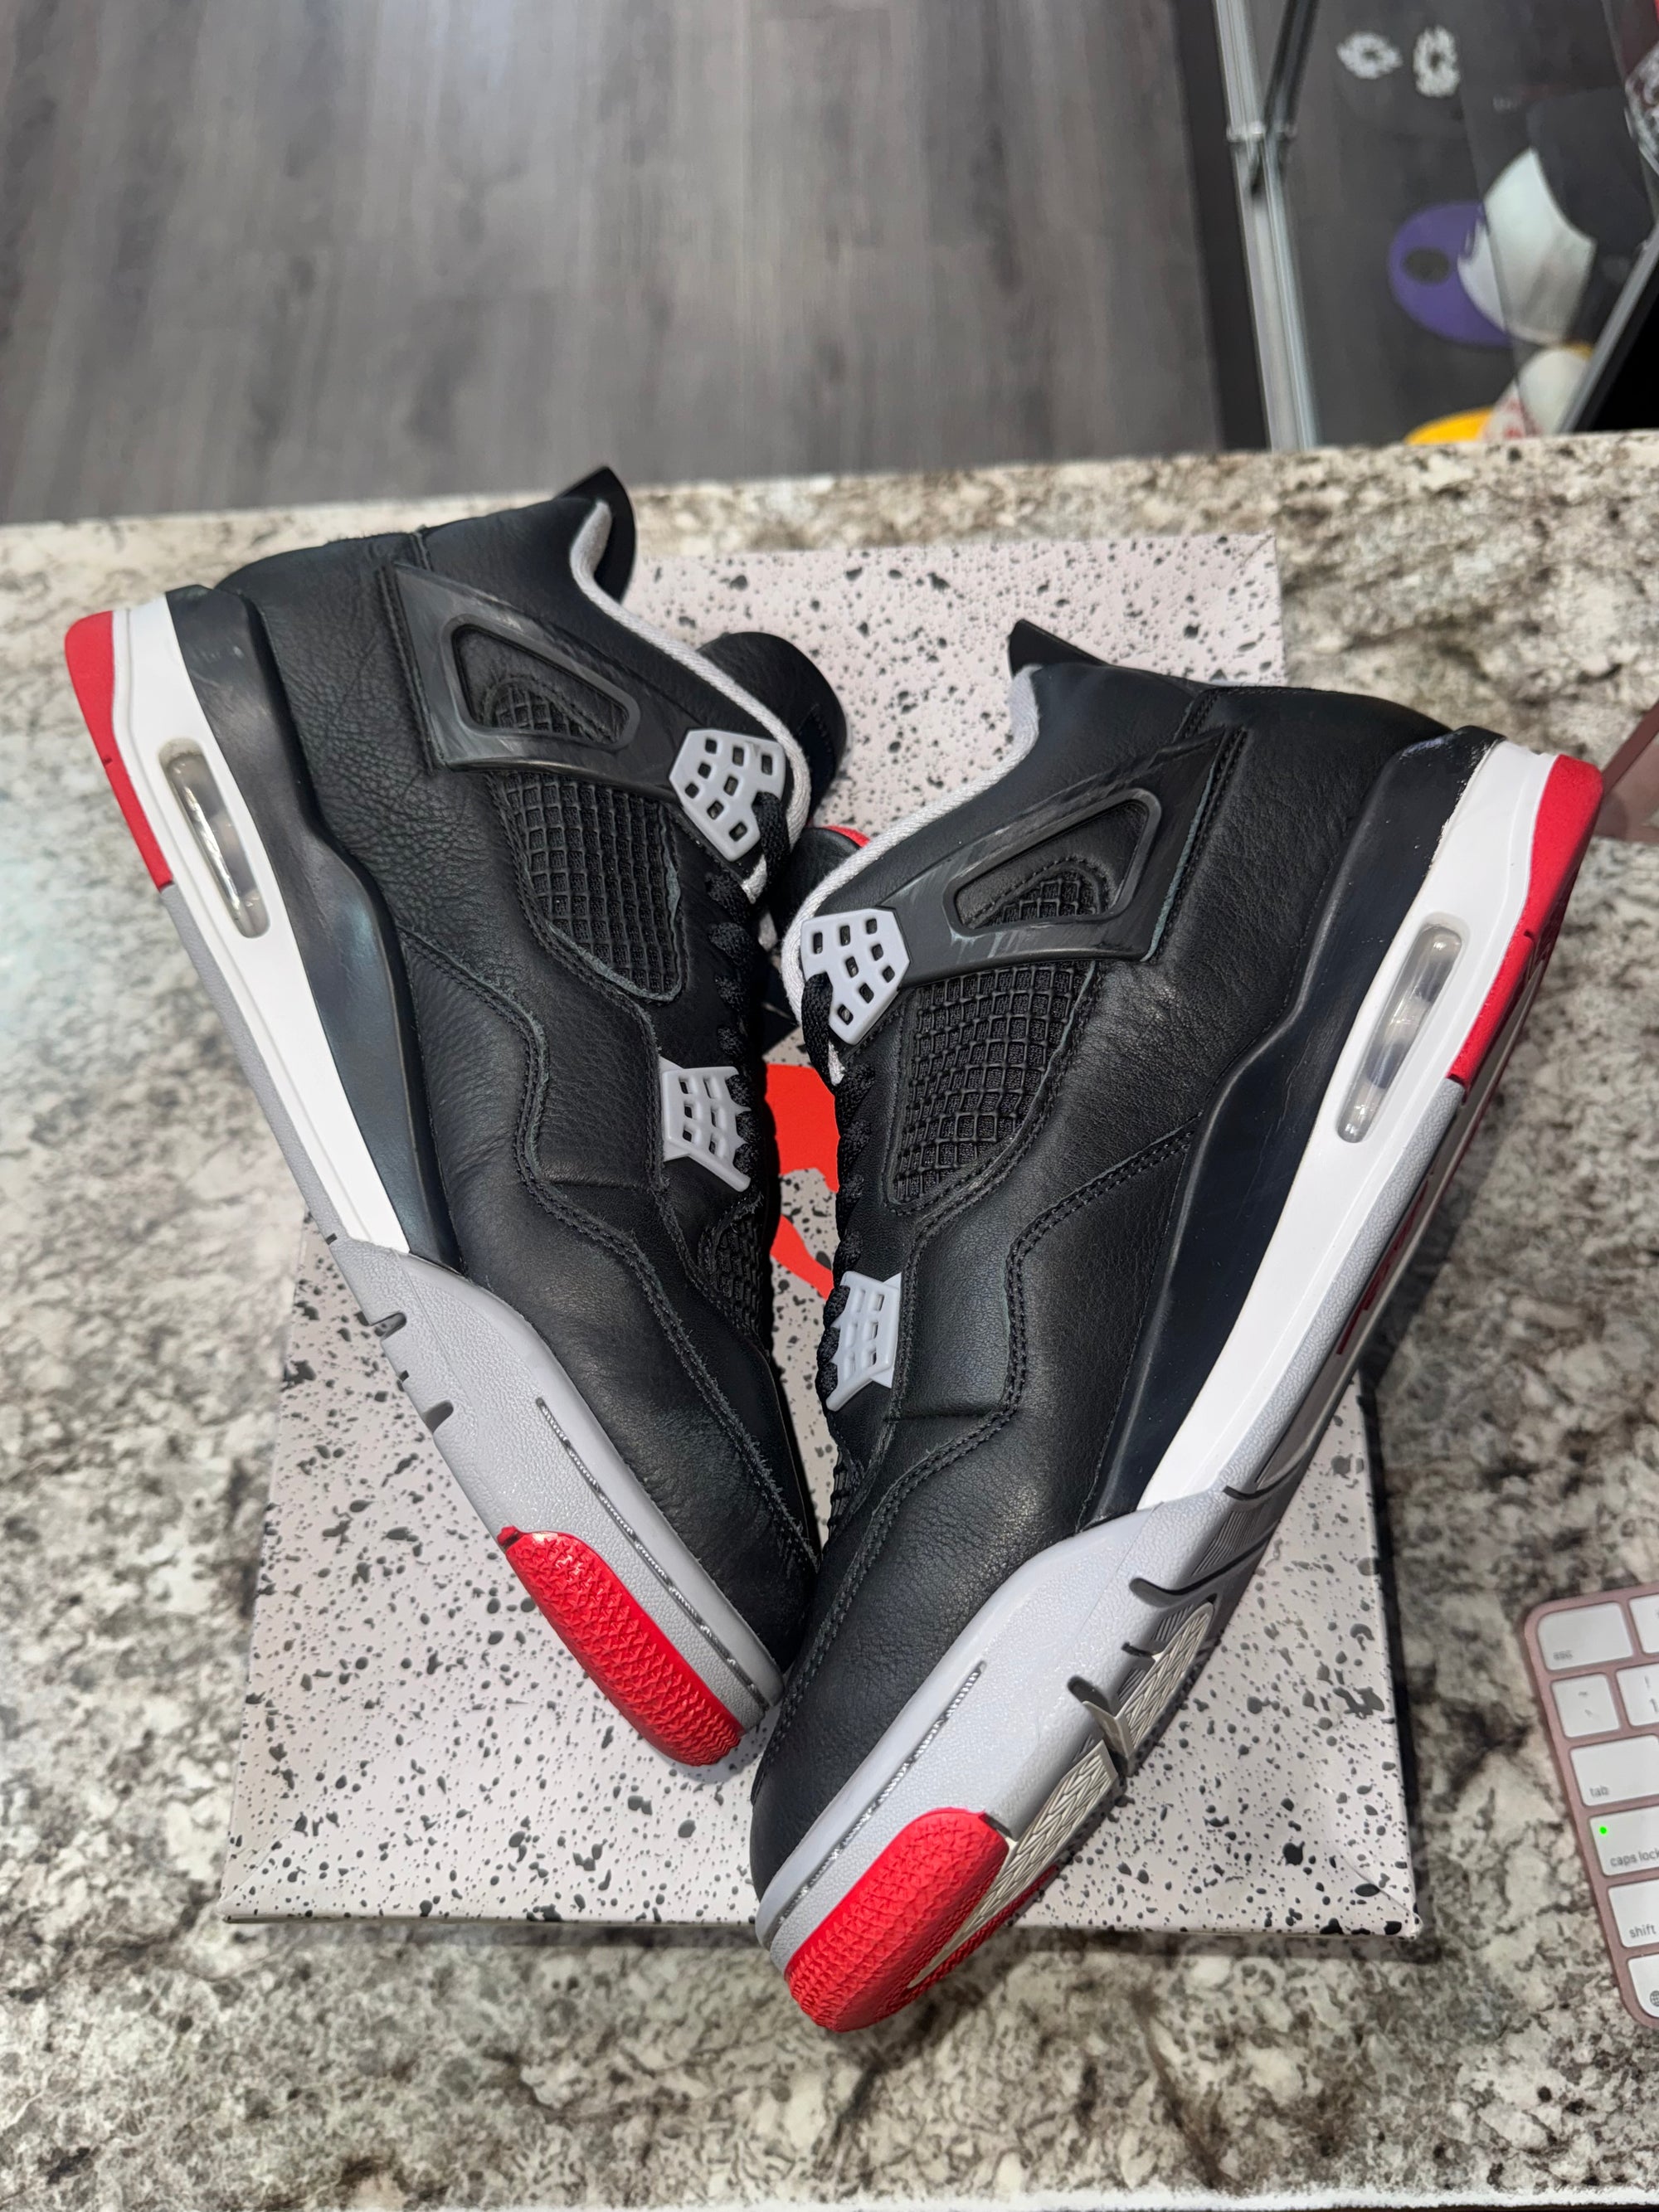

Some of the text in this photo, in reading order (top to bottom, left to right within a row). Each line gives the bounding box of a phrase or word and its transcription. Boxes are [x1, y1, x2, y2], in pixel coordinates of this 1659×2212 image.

[1589, 1786, 1609, 1797] tab
[1610, 1853, 1637, 1867] caps
[1629, 1924, 1657, 1938] shift
